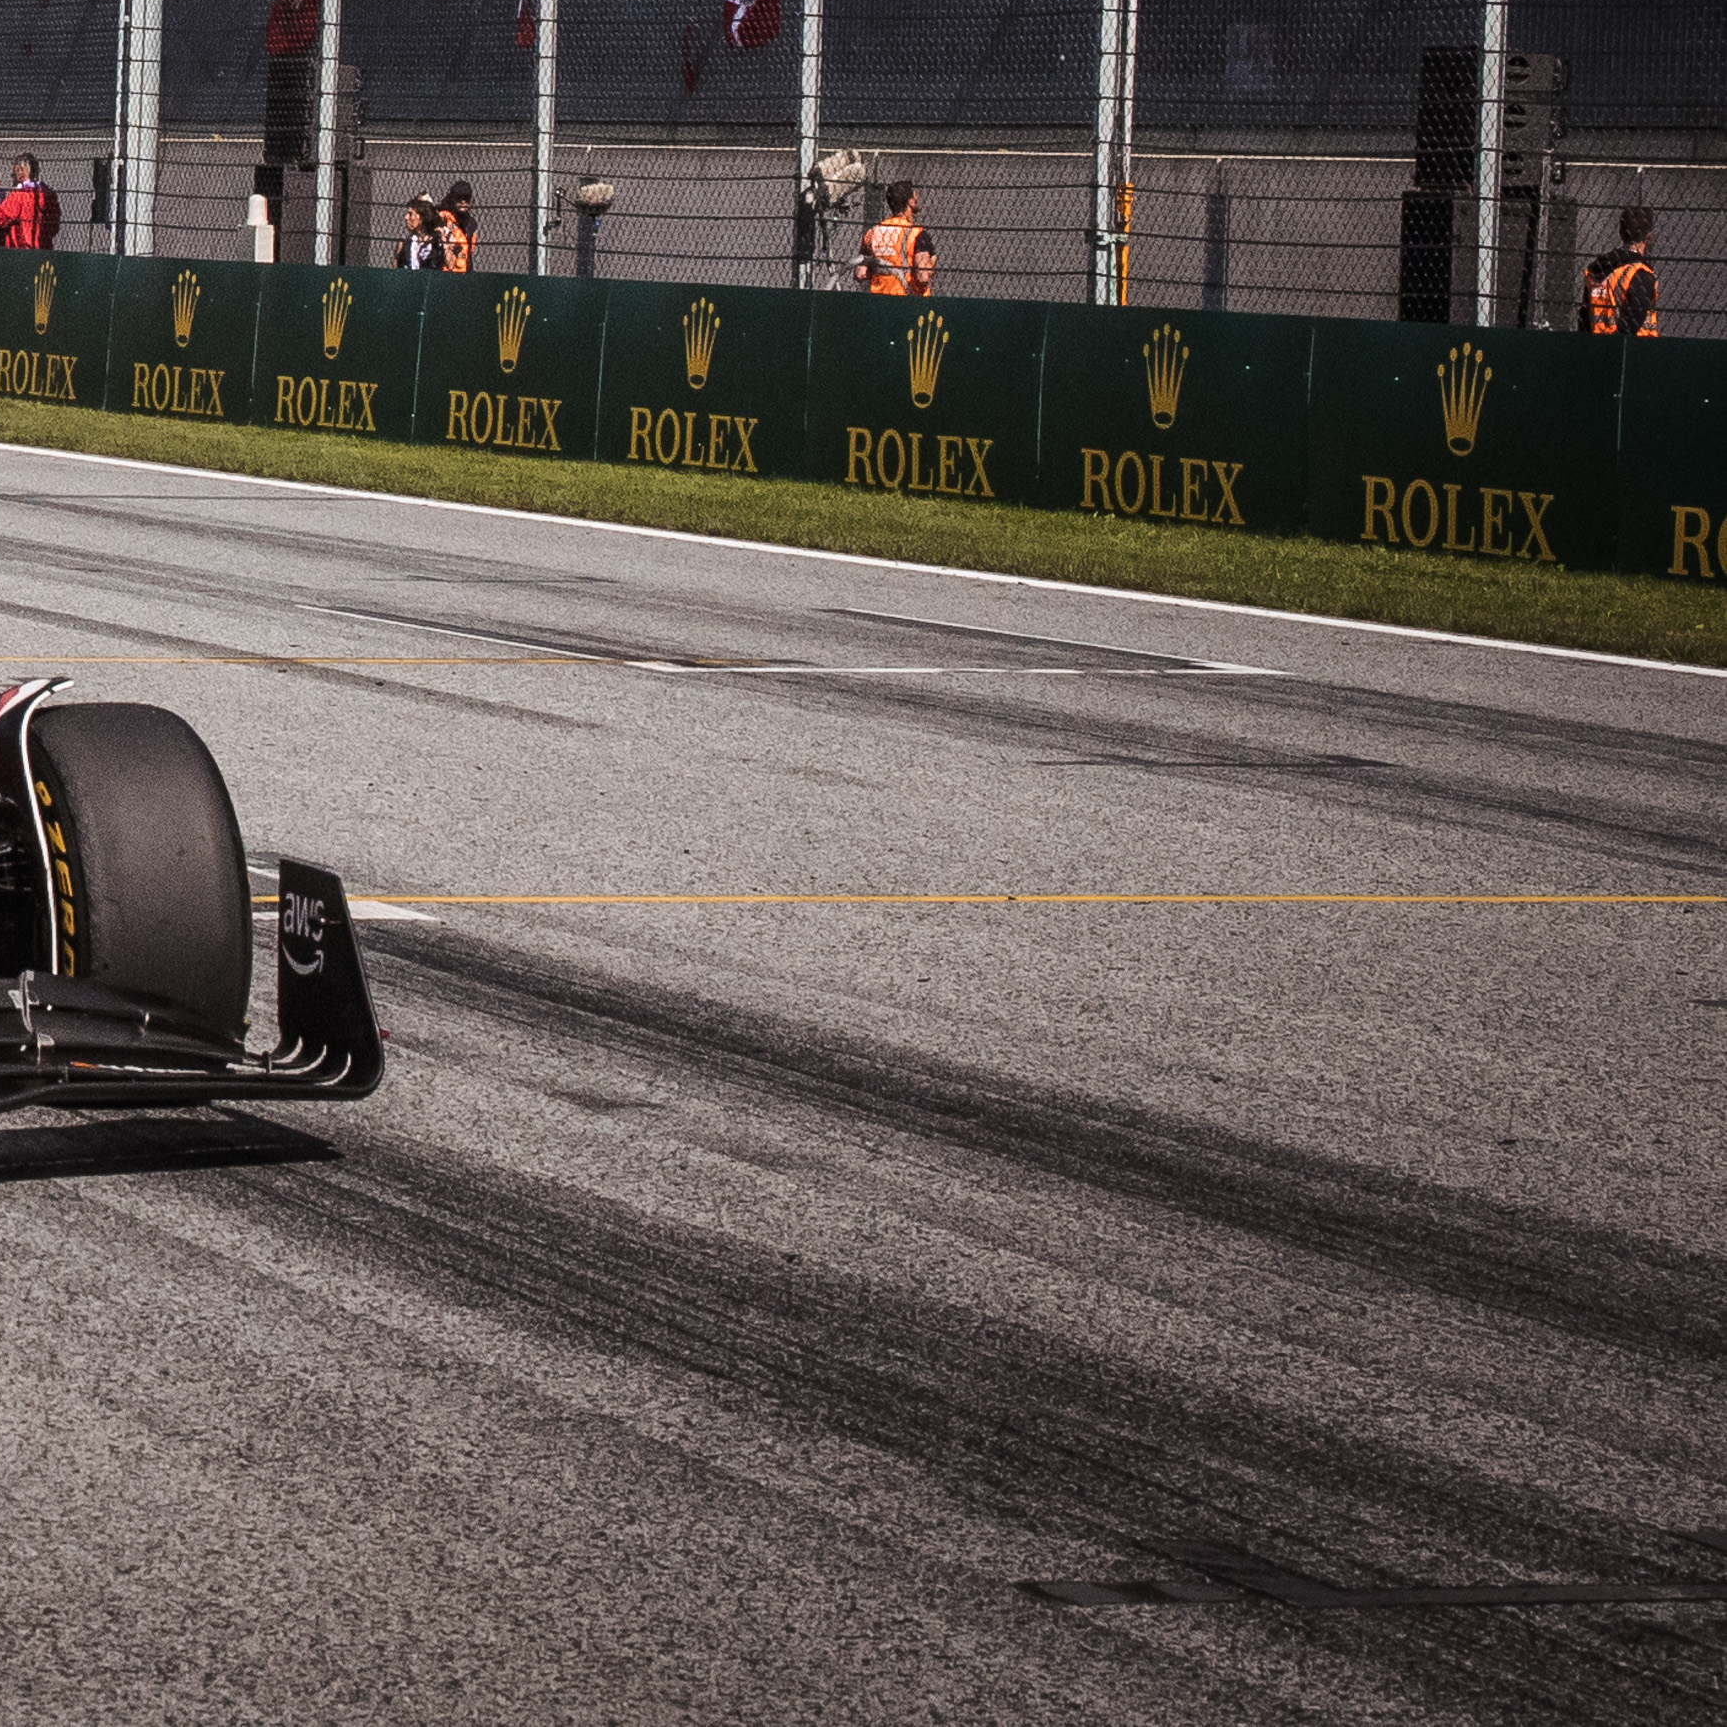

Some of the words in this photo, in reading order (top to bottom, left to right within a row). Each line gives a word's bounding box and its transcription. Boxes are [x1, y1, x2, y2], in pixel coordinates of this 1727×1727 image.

[132, 362, 225, 417] ROLEX
[275, 375, 378, 432] ROLEX
[446, 389, 562, 451] ROLEX
[629, 406, 759, 473] ROLEX
[845, 426, 995, 498] ROLEX
[1079, 447, 1245, 525] ROLEX
[1361, 475, 1555, 562] ROLEX
[283, 891, 325, 943] aws
